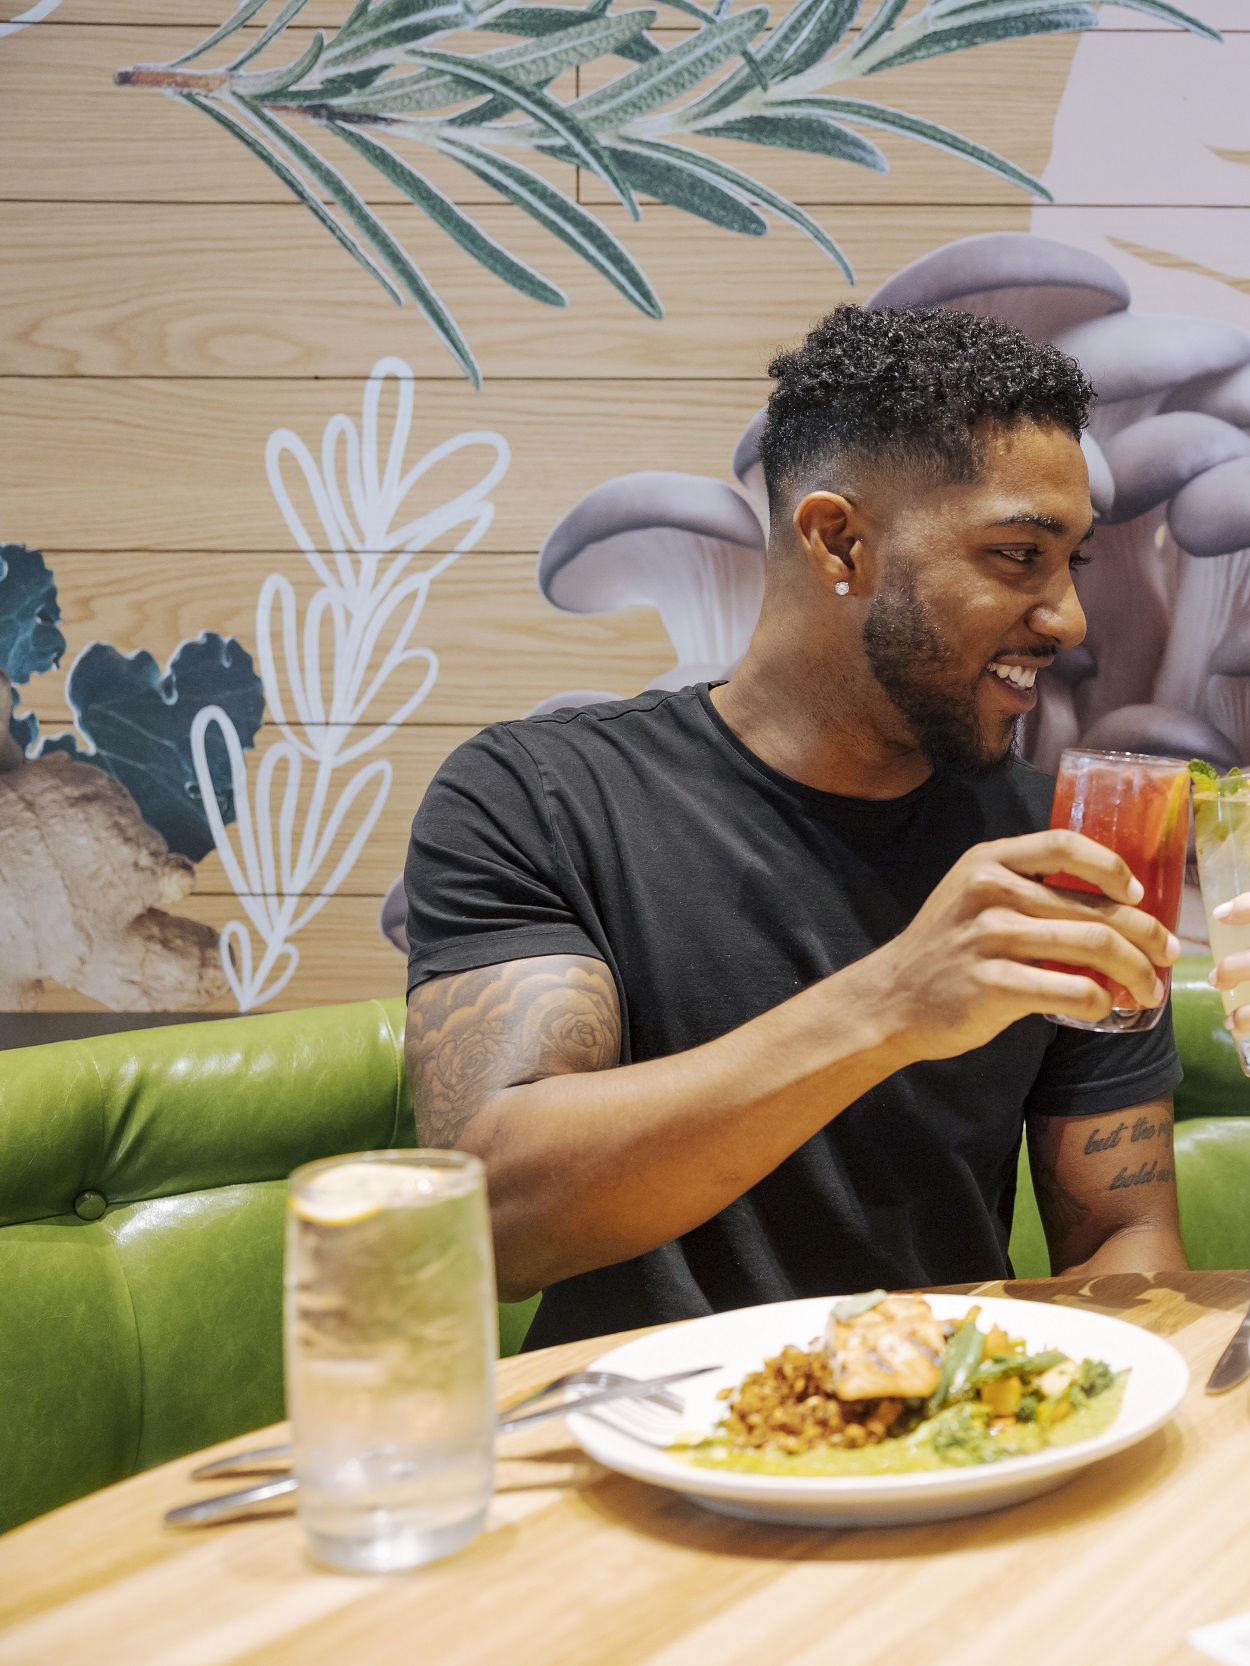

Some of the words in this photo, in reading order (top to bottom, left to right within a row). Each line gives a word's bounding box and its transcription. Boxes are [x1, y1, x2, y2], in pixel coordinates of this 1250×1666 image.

[1084, 1122, 1128, 1155] but
[1131, 1116, 1155, 1142] the
[1109, 1161, 1158, 1191] bold
